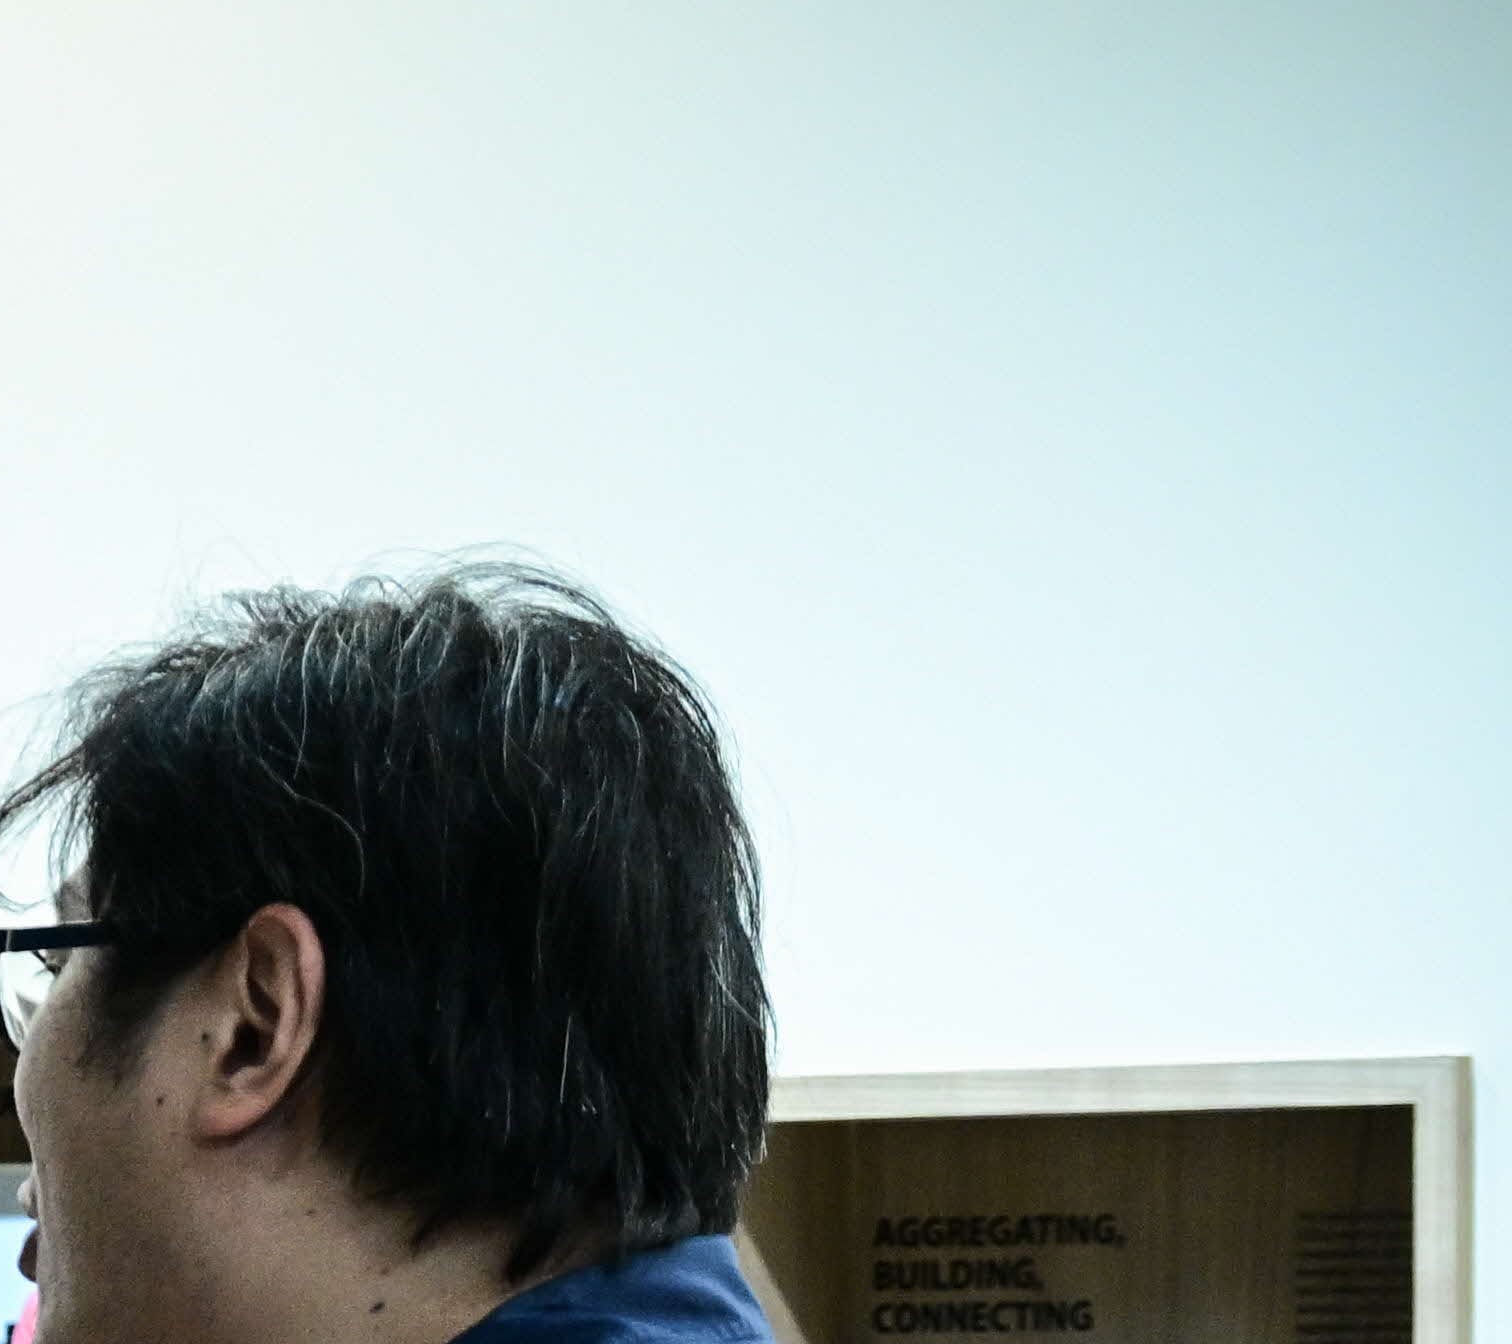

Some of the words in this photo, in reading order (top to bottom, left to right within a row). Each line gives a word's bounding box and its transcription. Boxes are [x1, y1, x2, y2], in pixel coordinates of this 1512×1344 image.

[874, 1213, 1128, 1248] AGGREGATING,
[873, 1257, 1045, 1292] BUILDING,
[872, 1300, 1095, 1334] CONNECTING
